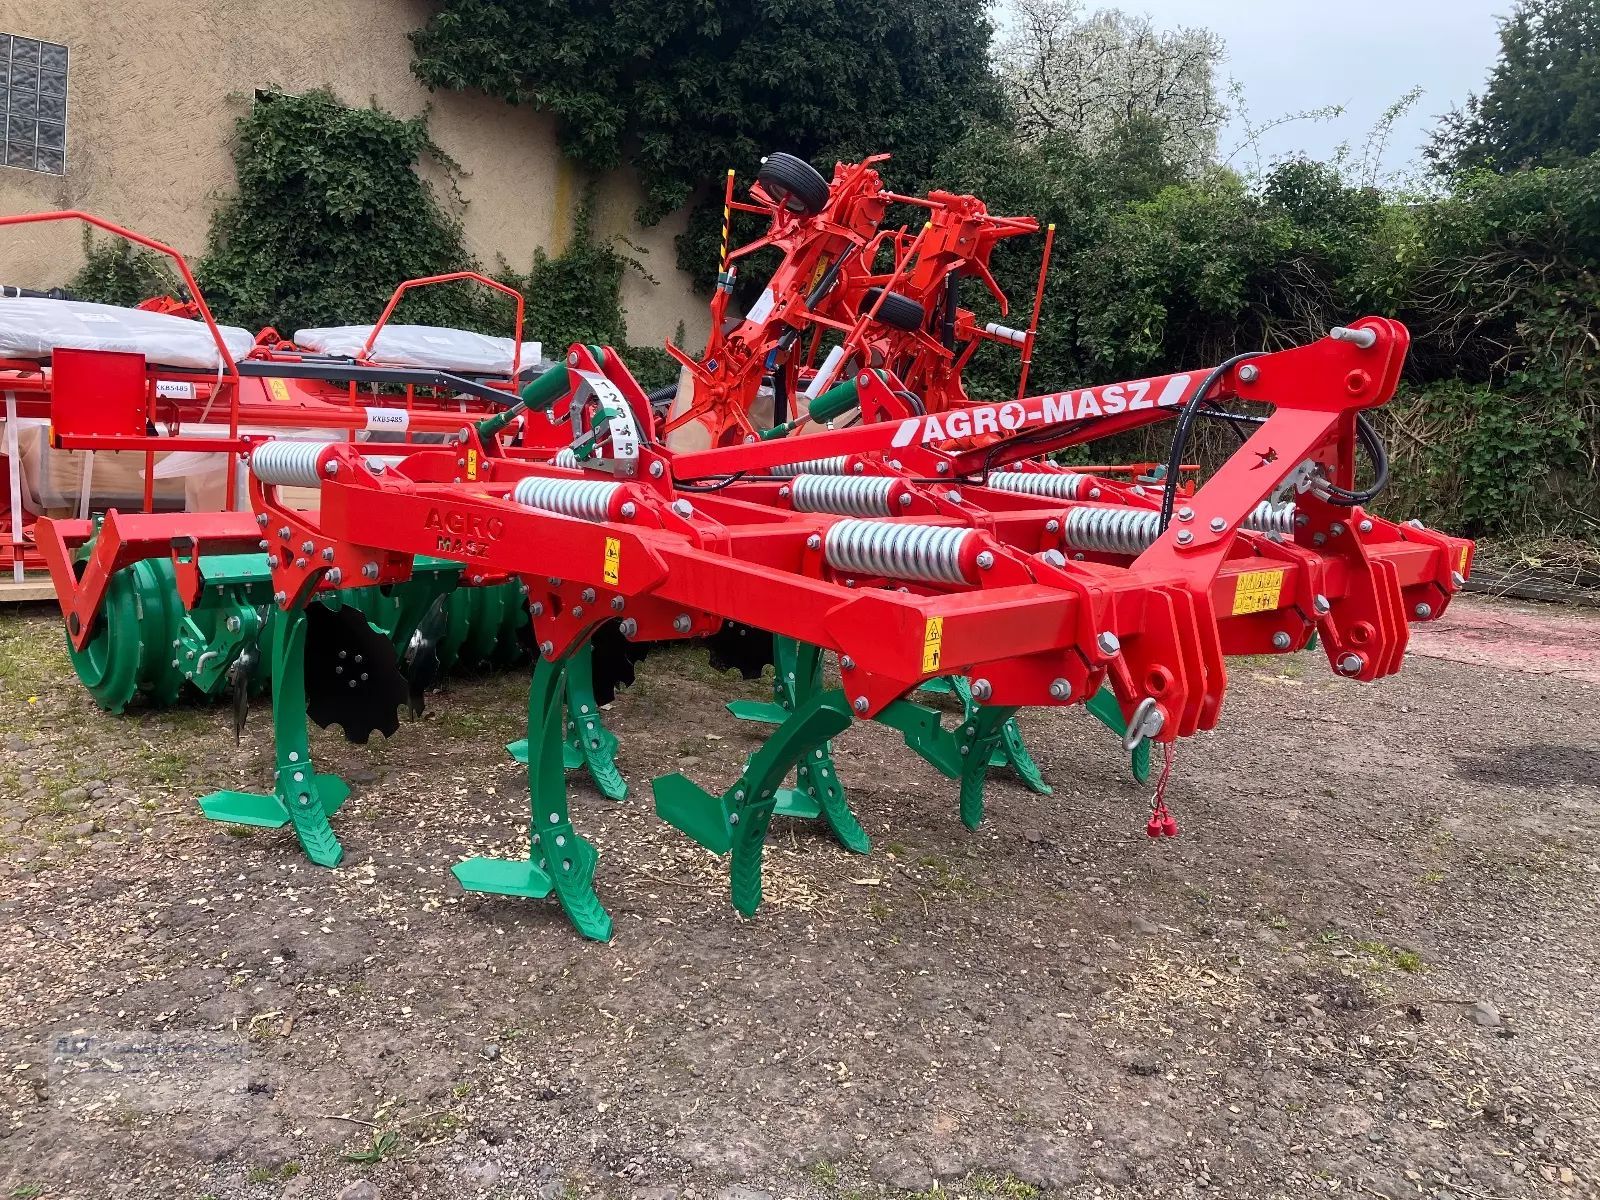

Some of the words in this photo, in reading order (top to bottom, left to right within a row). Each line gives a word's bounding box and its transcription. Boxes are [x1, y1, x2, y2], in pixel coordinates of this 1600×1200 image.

[921, 381, 1154, 444] AGRO-MASZ
[424, 507, 504, 541] AGRO
[436, 535, 489, 559] MASZ
